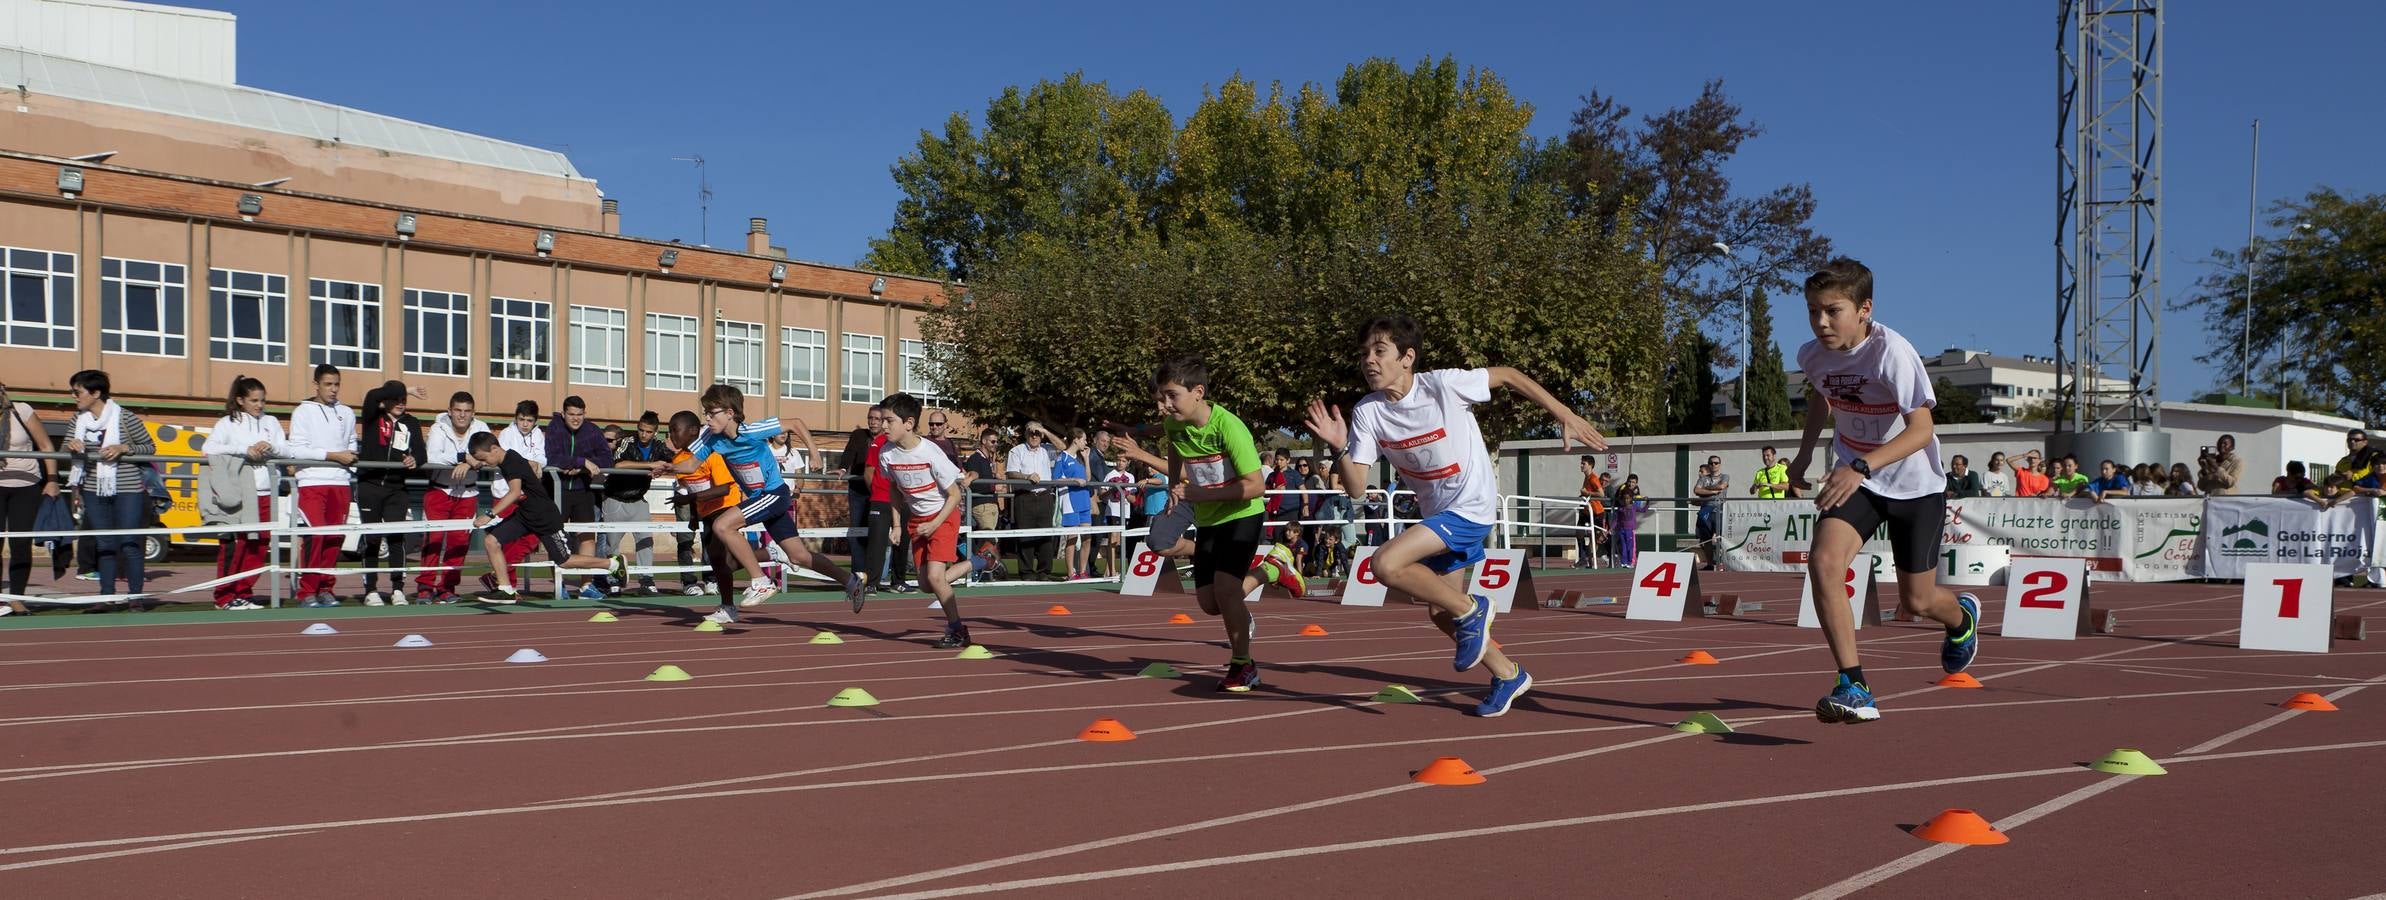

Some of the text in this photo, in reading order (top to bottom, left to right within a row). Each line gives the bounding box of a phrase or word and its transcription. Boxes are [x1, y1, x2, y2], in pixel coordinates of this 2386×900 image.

[1852, 417, 1880, 439] 91
[903, 472, 923, 486] 95
[2002, 513, 2055, 529] Hazte
[2060, 514, 2121, 534] grande
[1986, 535, 2112, 551] con nosotros !!
[2178, 538, 2194, 551] El
[2276, 530, 2357, 543] Gobierno
[2276, 545, 2298, 558] de
[2303, 545, 2325, 558] La
[1132, 550, 1160, 577] 8
[1478, 558, 1511, 590] 5
[1639, 561, 1682, 597] 4
[2019, 570, 2069, 610] 2
[2271, 577, 2304, 619] 1
